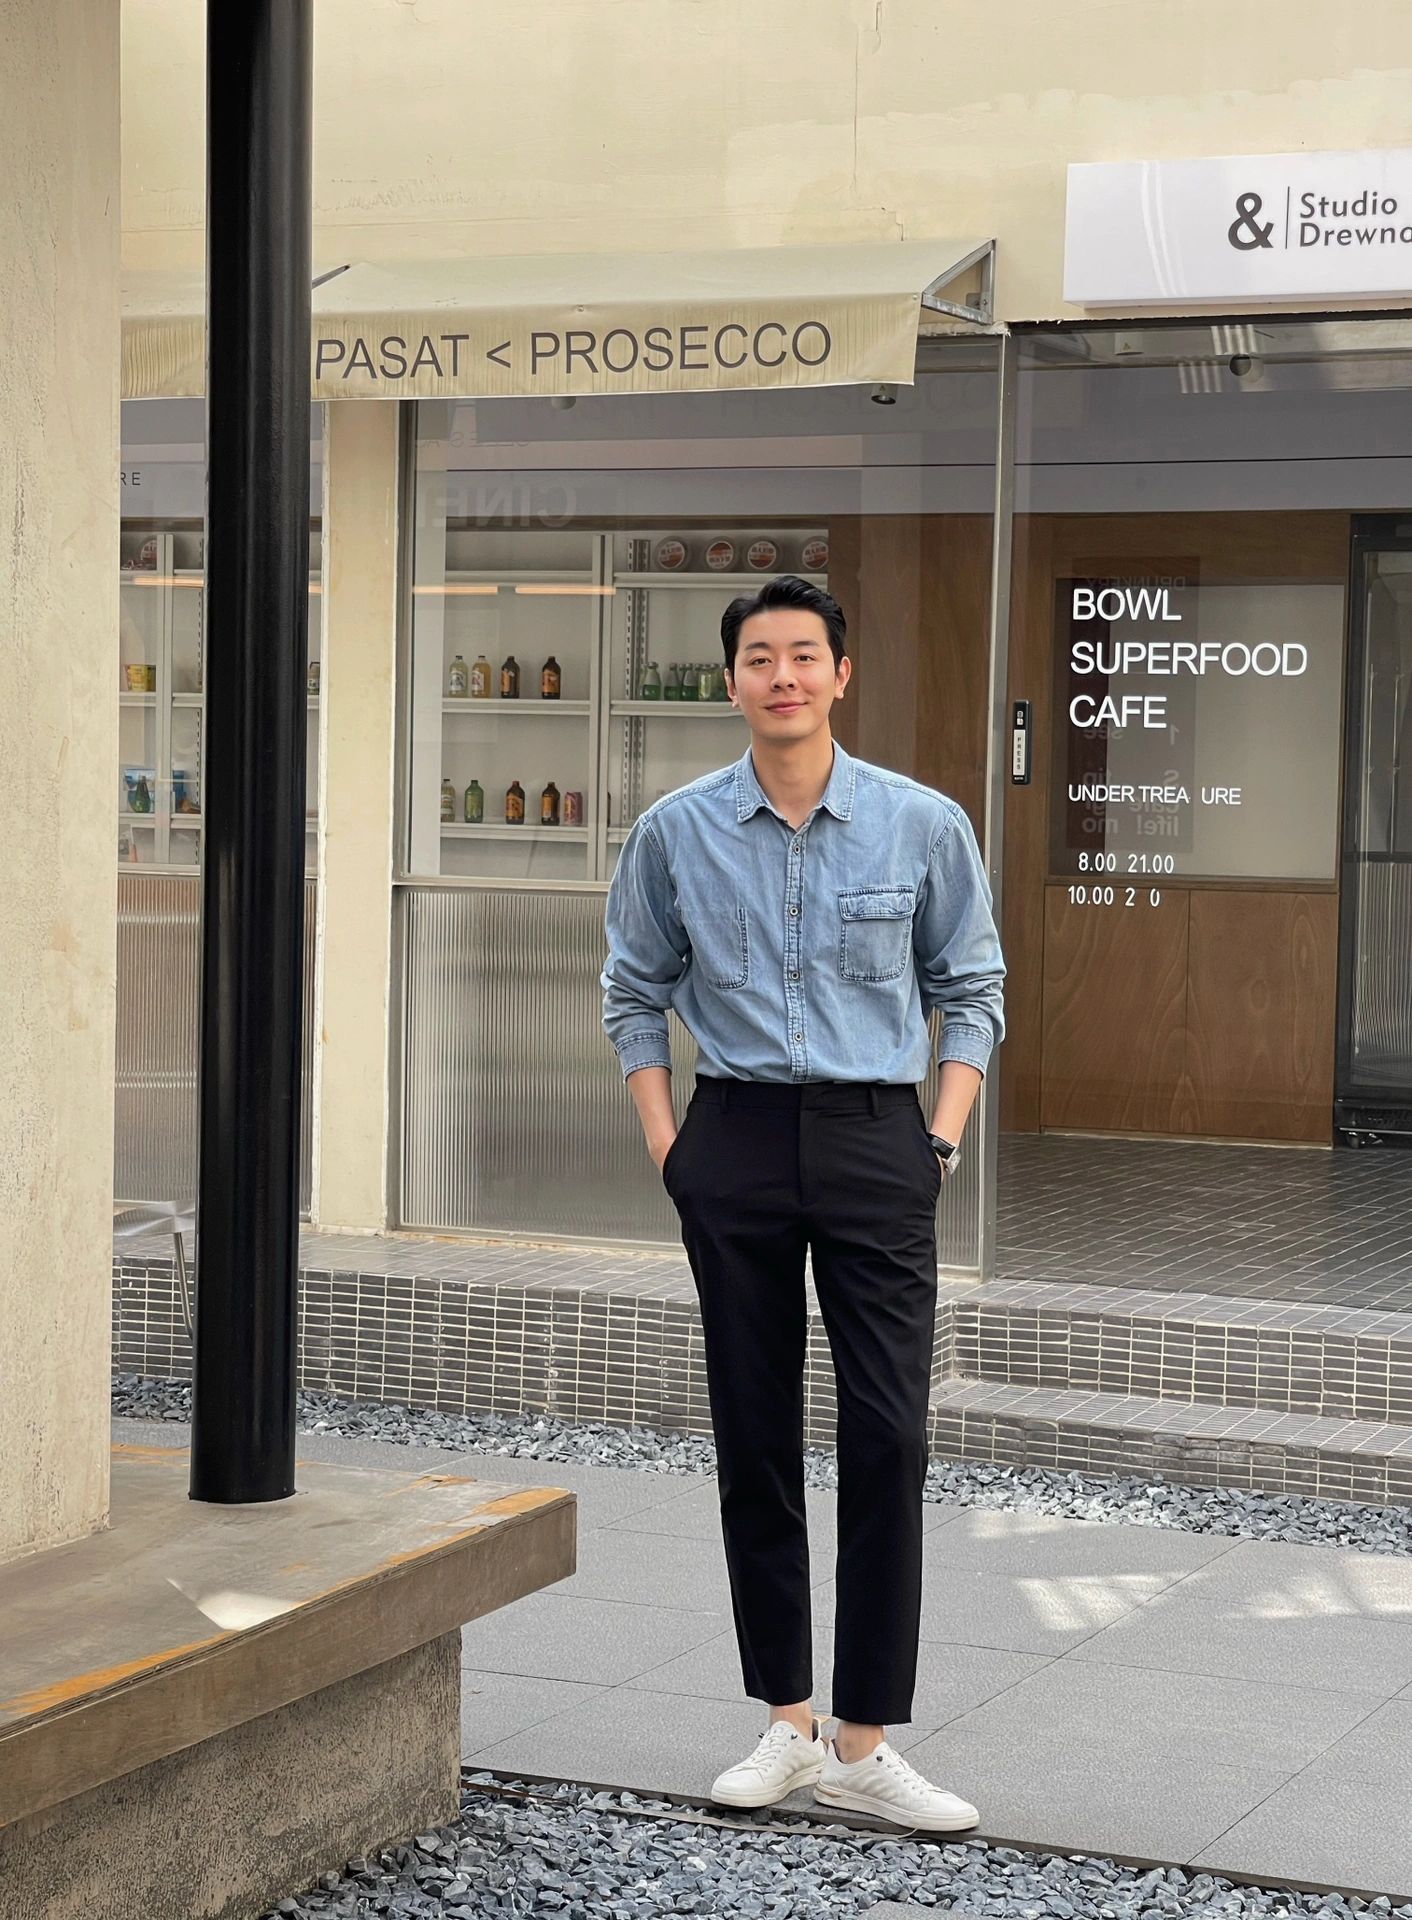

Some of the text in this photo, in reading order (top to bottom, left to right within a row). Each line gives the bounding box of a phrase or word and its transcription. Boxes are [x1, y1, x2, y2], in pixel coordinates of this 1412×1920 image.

[1300, 190, 1398, 219] Studio
[315, 334, 470, 380] PASAT
[531, 321, 832, 375] PROSECCO
[1072, 588, 1182, 621] BOWL
[1070, 641, 1308, 676] SUPERFOOD
[1069, 694, 1167, 729] CAFE
[1068, 784, 1135, 803] UNDER
[1201, 787, 1242, 805] URE
[1078, 852, 1175, 874] 8.00 21.00
[1068, 885, 1114, 906] 10.00
[1125, 887, 1136, 907] 2
